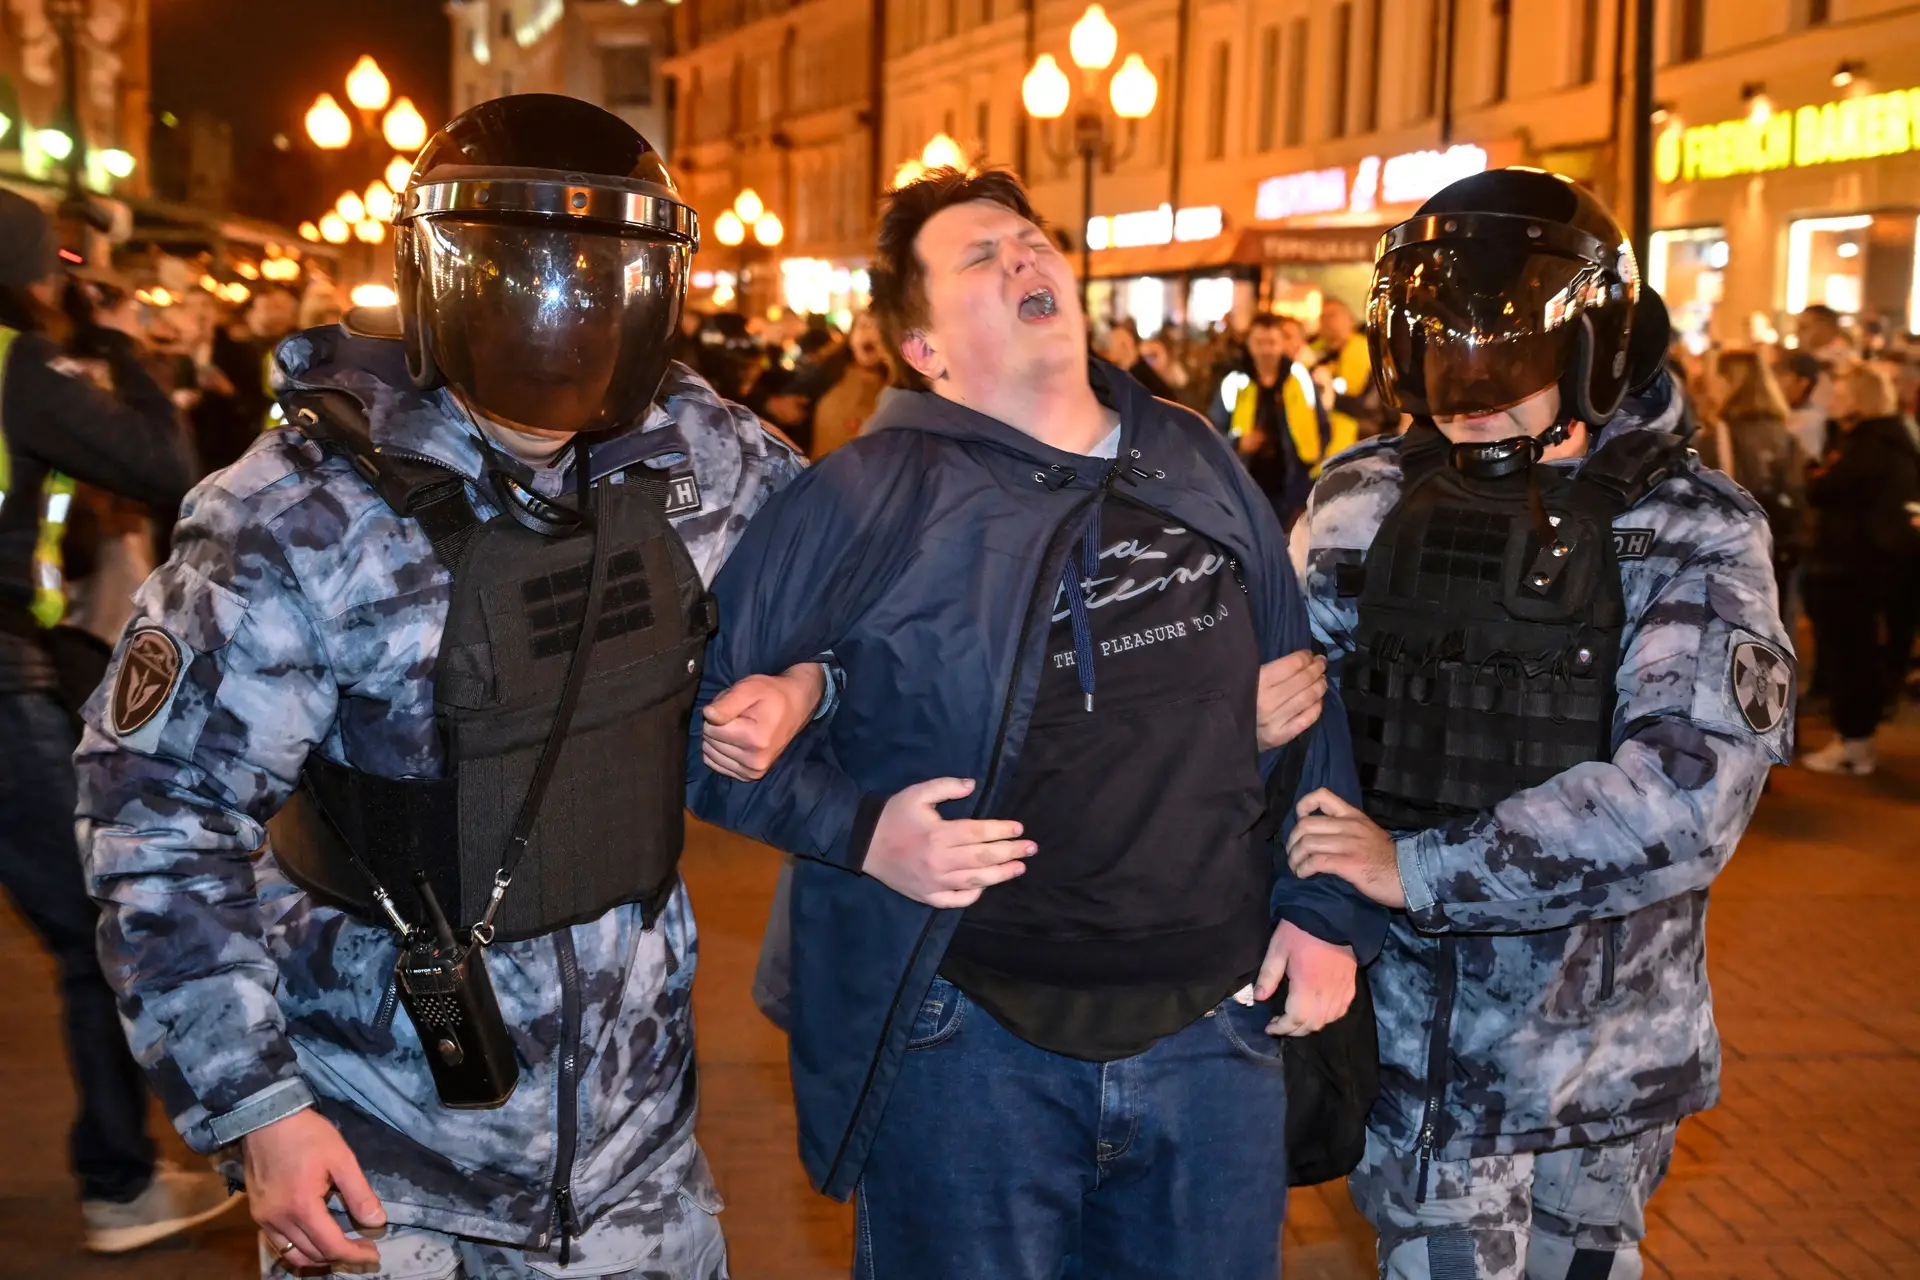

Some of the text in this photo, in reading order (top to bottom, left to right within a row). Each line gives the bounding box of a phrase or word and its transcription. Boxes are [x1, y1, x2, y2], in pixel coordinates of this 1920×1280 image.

[1053, 614, 1215, 669] TH PLEASURE TO
